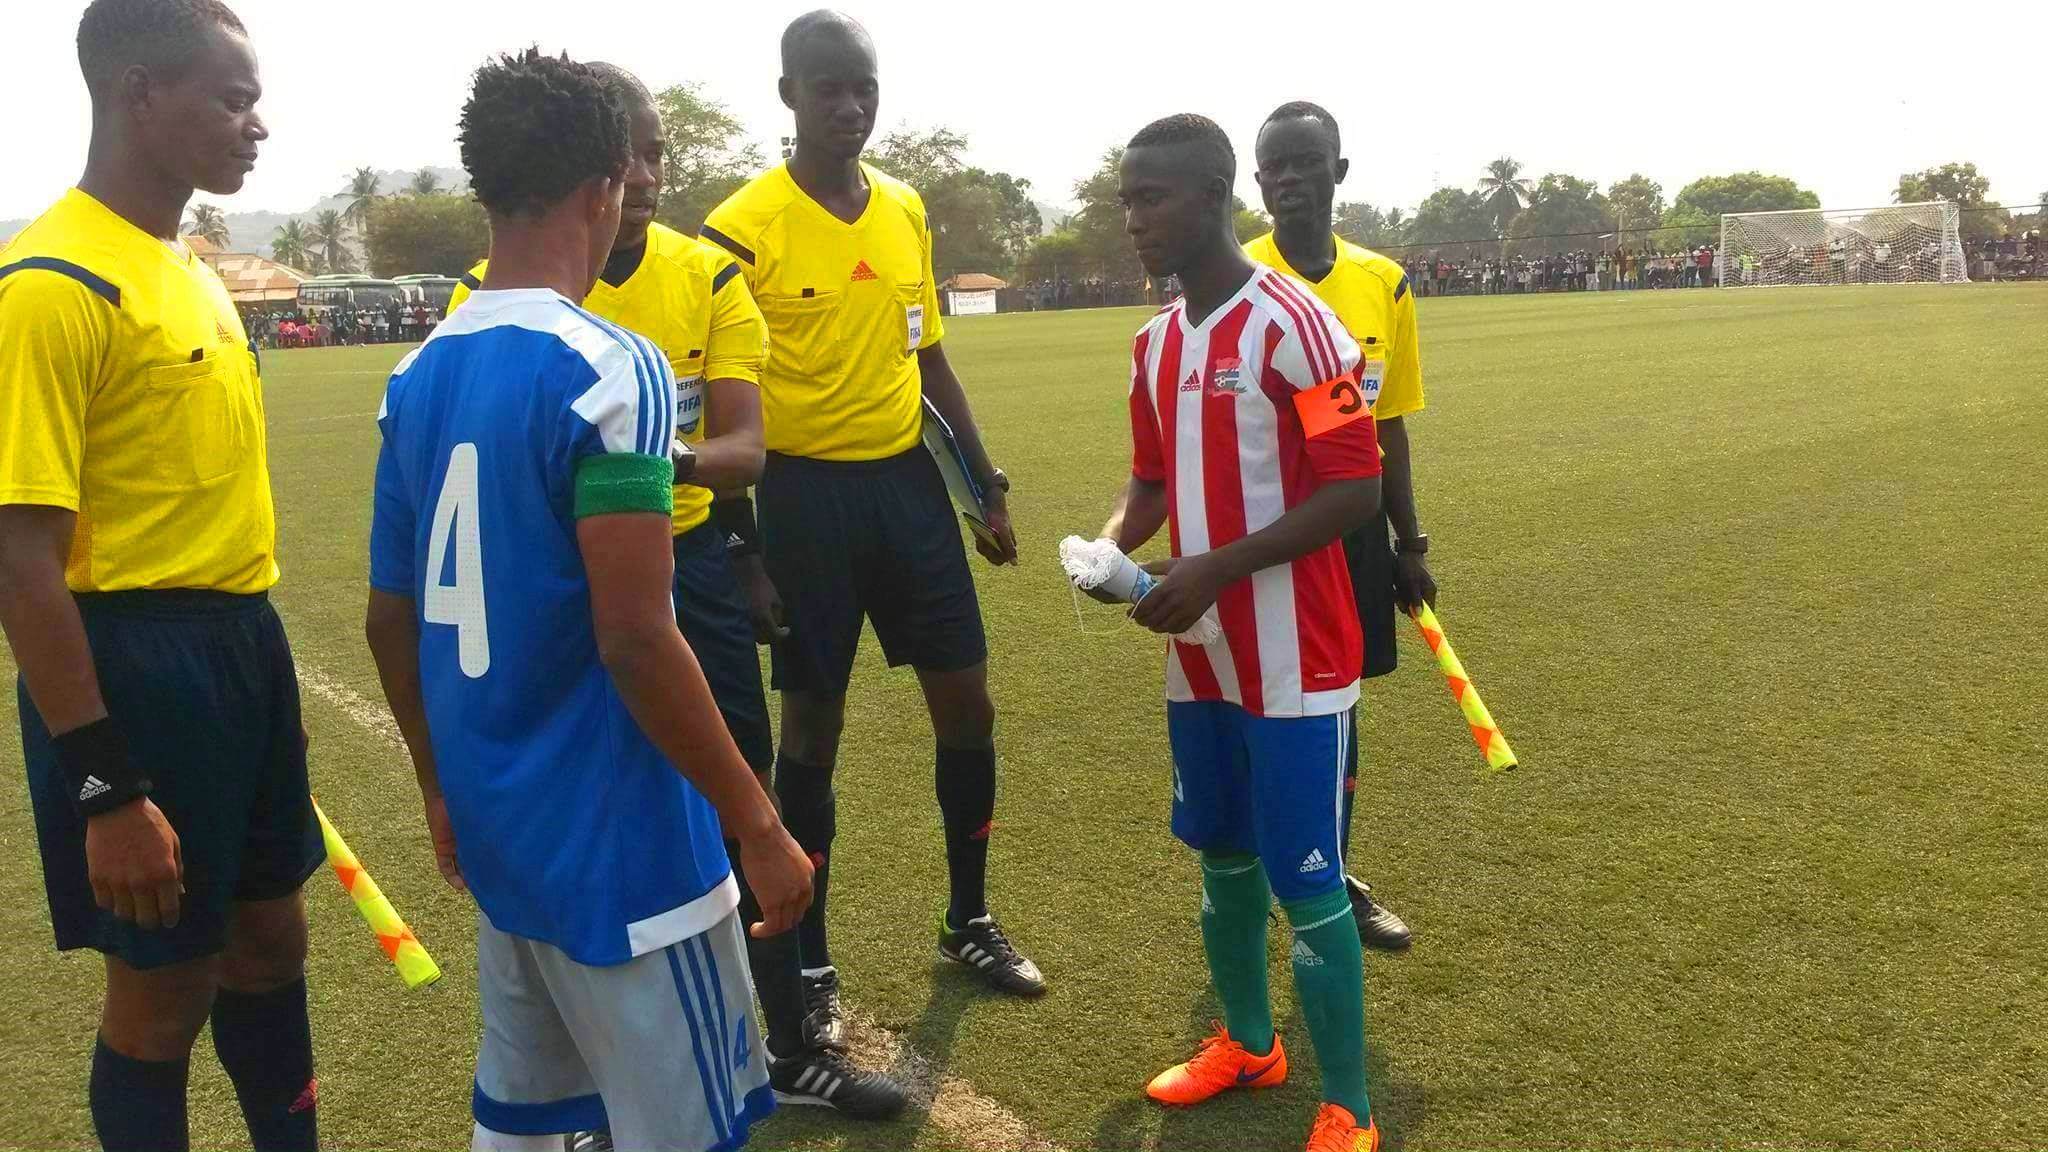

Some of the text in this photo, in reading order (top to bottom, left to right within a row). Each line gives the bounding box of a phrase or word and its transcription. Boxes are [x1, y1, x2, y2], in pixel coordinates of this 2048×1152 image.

[851, 272, 878, 281] adidas
[1180, 384, 1202, 393] adidas
[1360, 379, 1379, 391] IFA
[677, 394, 700, 415] FIFA
[424, 442, 490, 678] 4
[79, 783, 112, 801] adidas
[1300, 860, 1329, 873] adidas
[734, 1013, 751, 1071] 4
